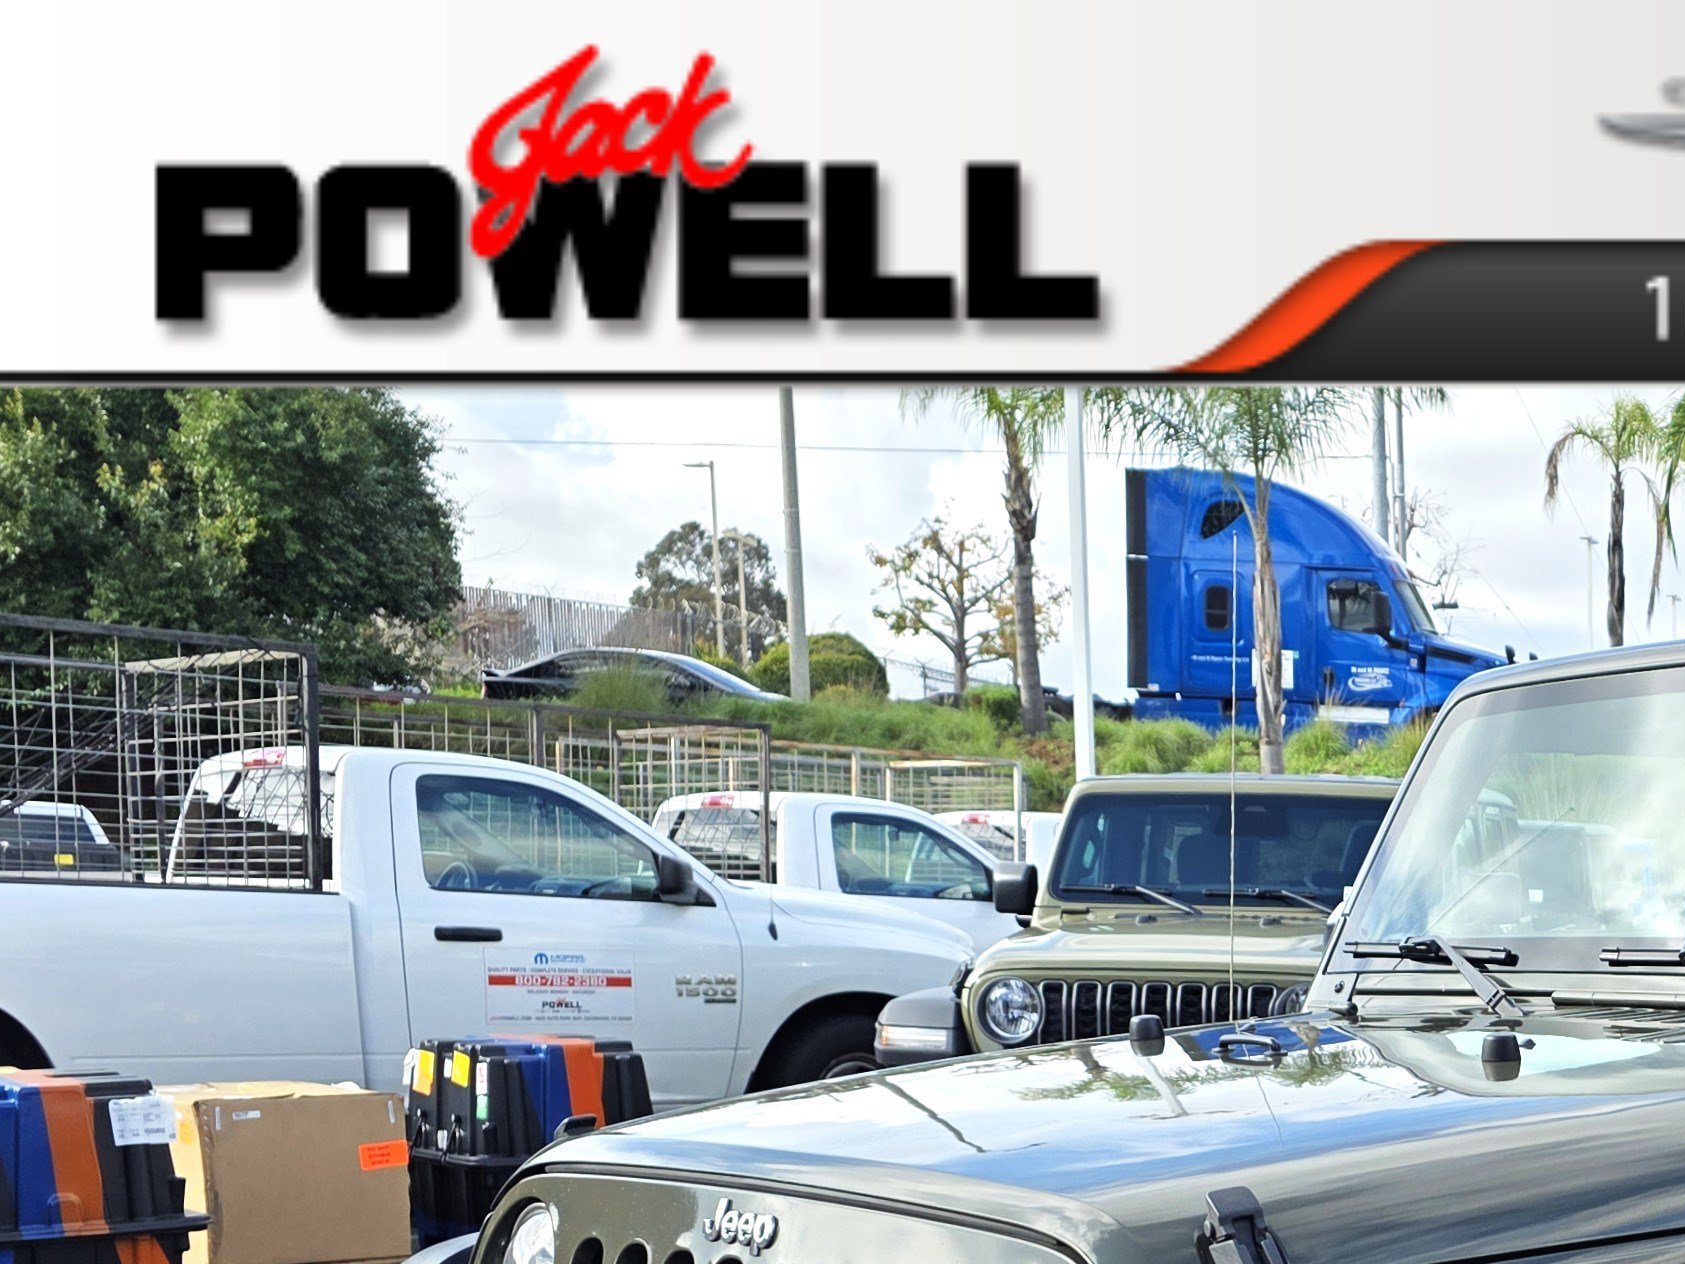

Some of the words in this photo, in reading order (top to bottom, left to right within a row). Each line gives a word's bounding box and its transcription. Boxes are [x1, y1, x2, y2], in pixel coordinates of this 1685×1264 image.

[675, 974, 737, 985] RAM
[676, 987, 737, 998] 1500
[703, 1198, 778, 1257] Jeep
